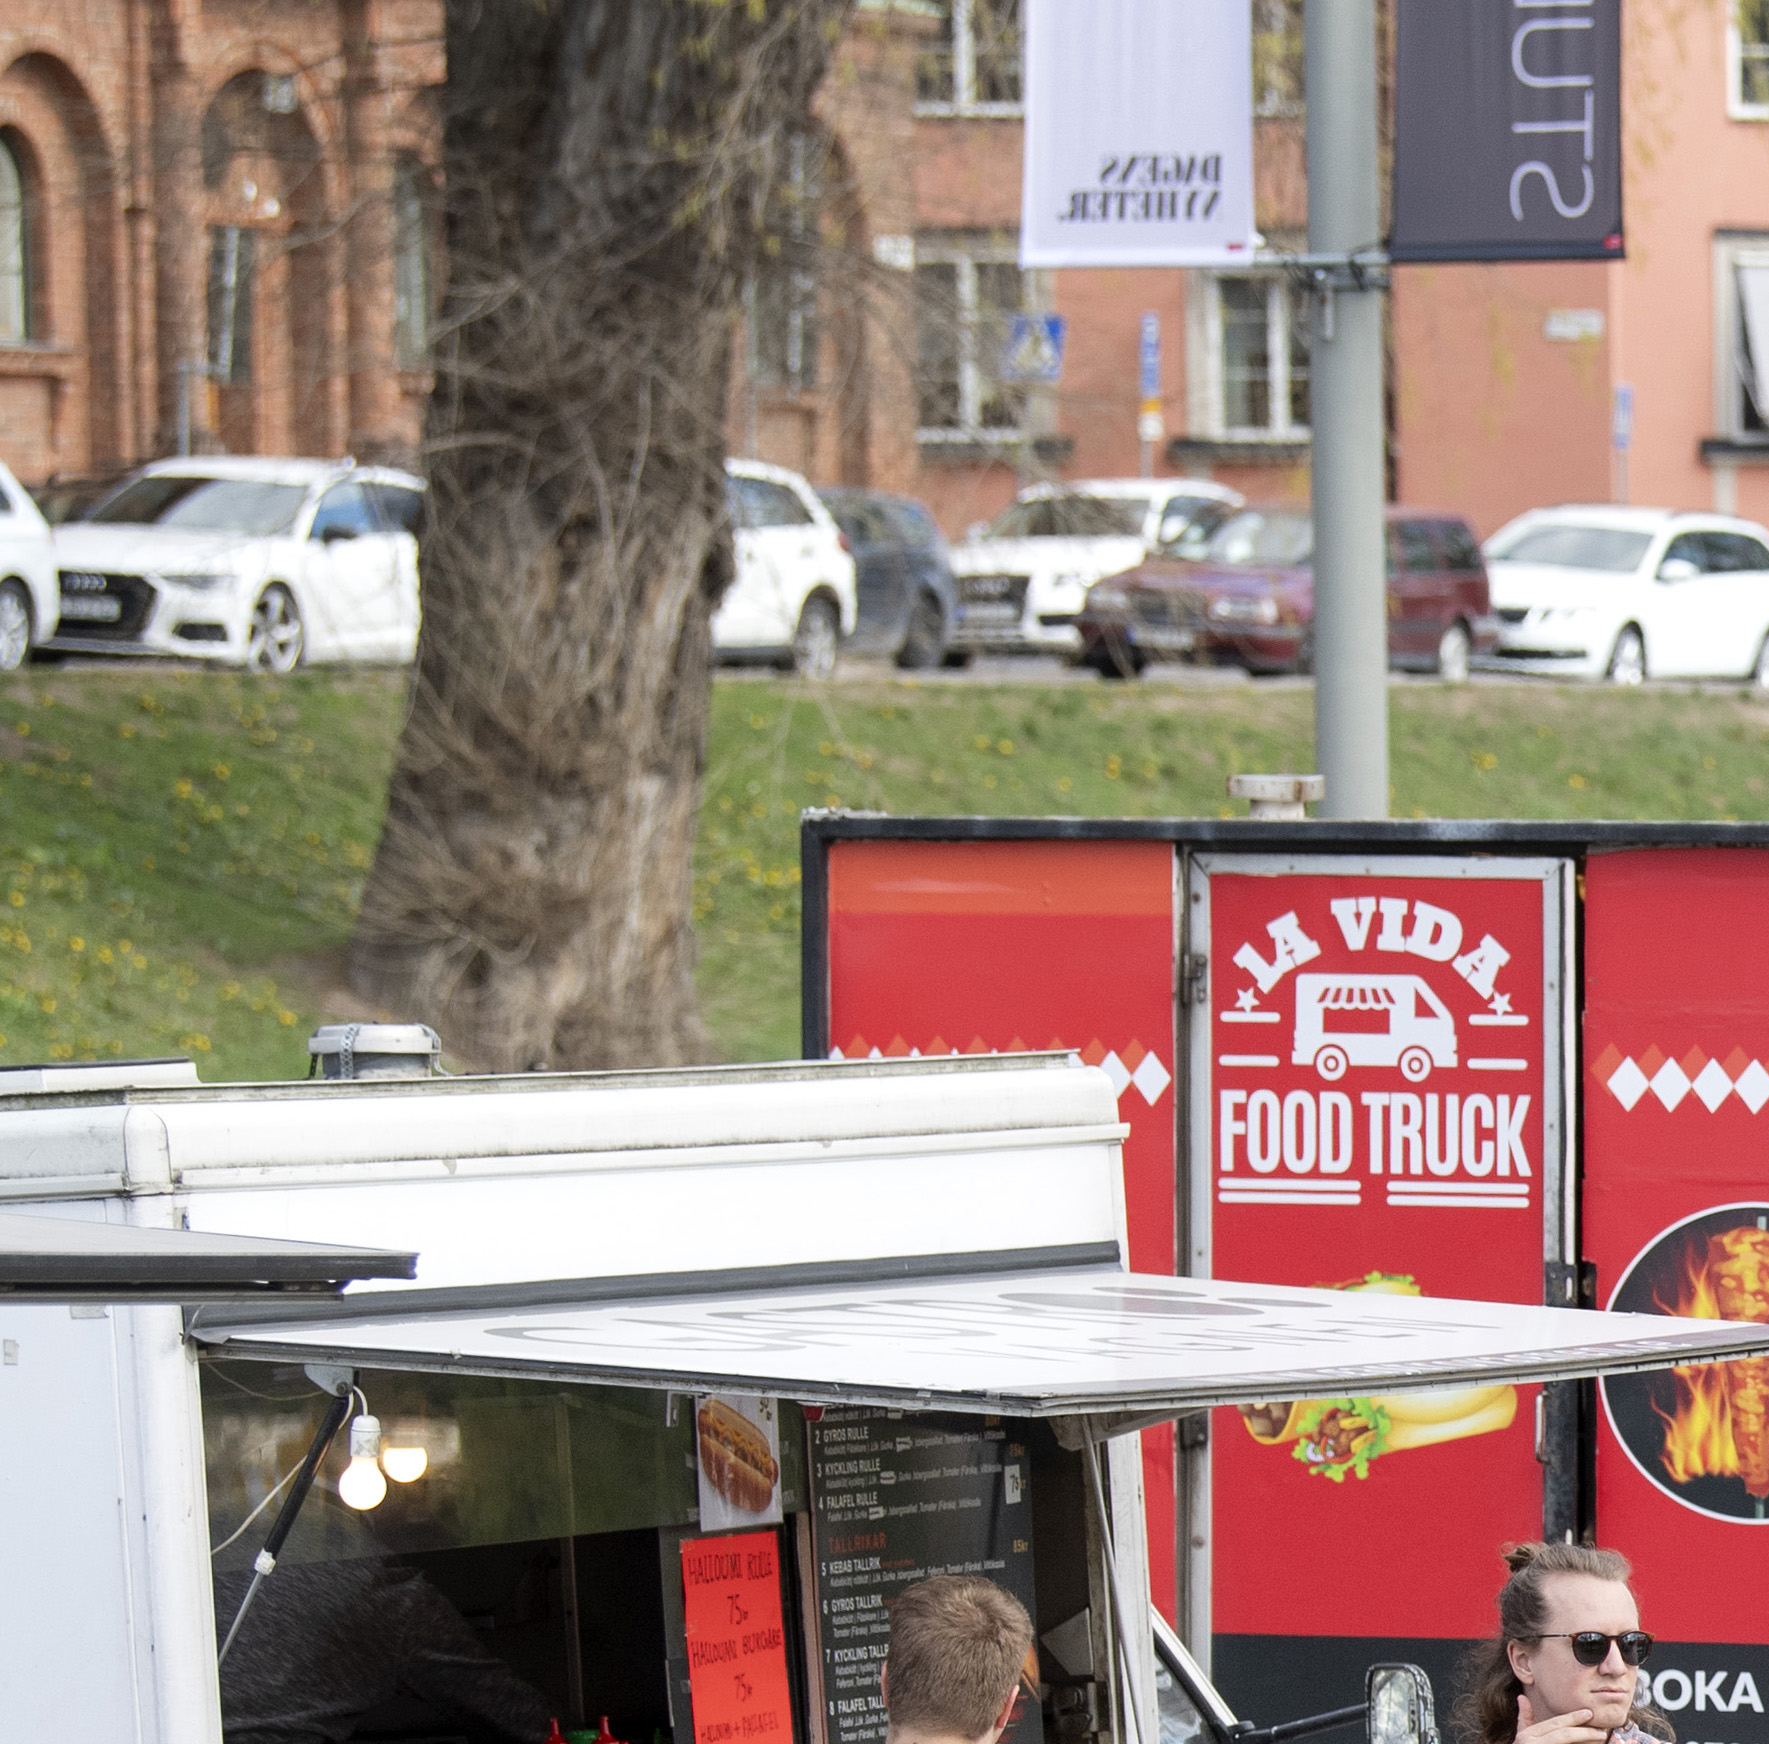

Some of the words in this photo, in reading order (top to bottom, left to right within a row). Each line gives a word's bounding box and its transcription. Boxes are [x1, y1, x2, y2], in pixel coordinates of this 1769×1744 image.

[1232, 909, 1321, 995] LA
[1330, 896, 1511, 1001] VIDA
[1219, 1088, 1353, 1174] FOOD
[1361, 1091, 1532, 1178] TRUCK
[823, 1428, 846, 1442] GYROS
[825, 1460, 859, 1475] KYCKLING
[859, 1458, 881, 1472] RULLE
[826, 1494, 855, 1509] FALAFEL
[856, 1491, 878, 1506] RULLE
[828, 1532, 887, 1554] TALLRIKAR
[829, 1559, 853, 1574] KEBAB
[854, 1557, 881, 1571] TALLRIK
[831, 1597, 855, 1612] GYROS
[834, 1647, 868, 1663] KYCKLING
[837, 1698, 867, 1713] FALAFEL
[868, 1695, 885, 1710] TALL
